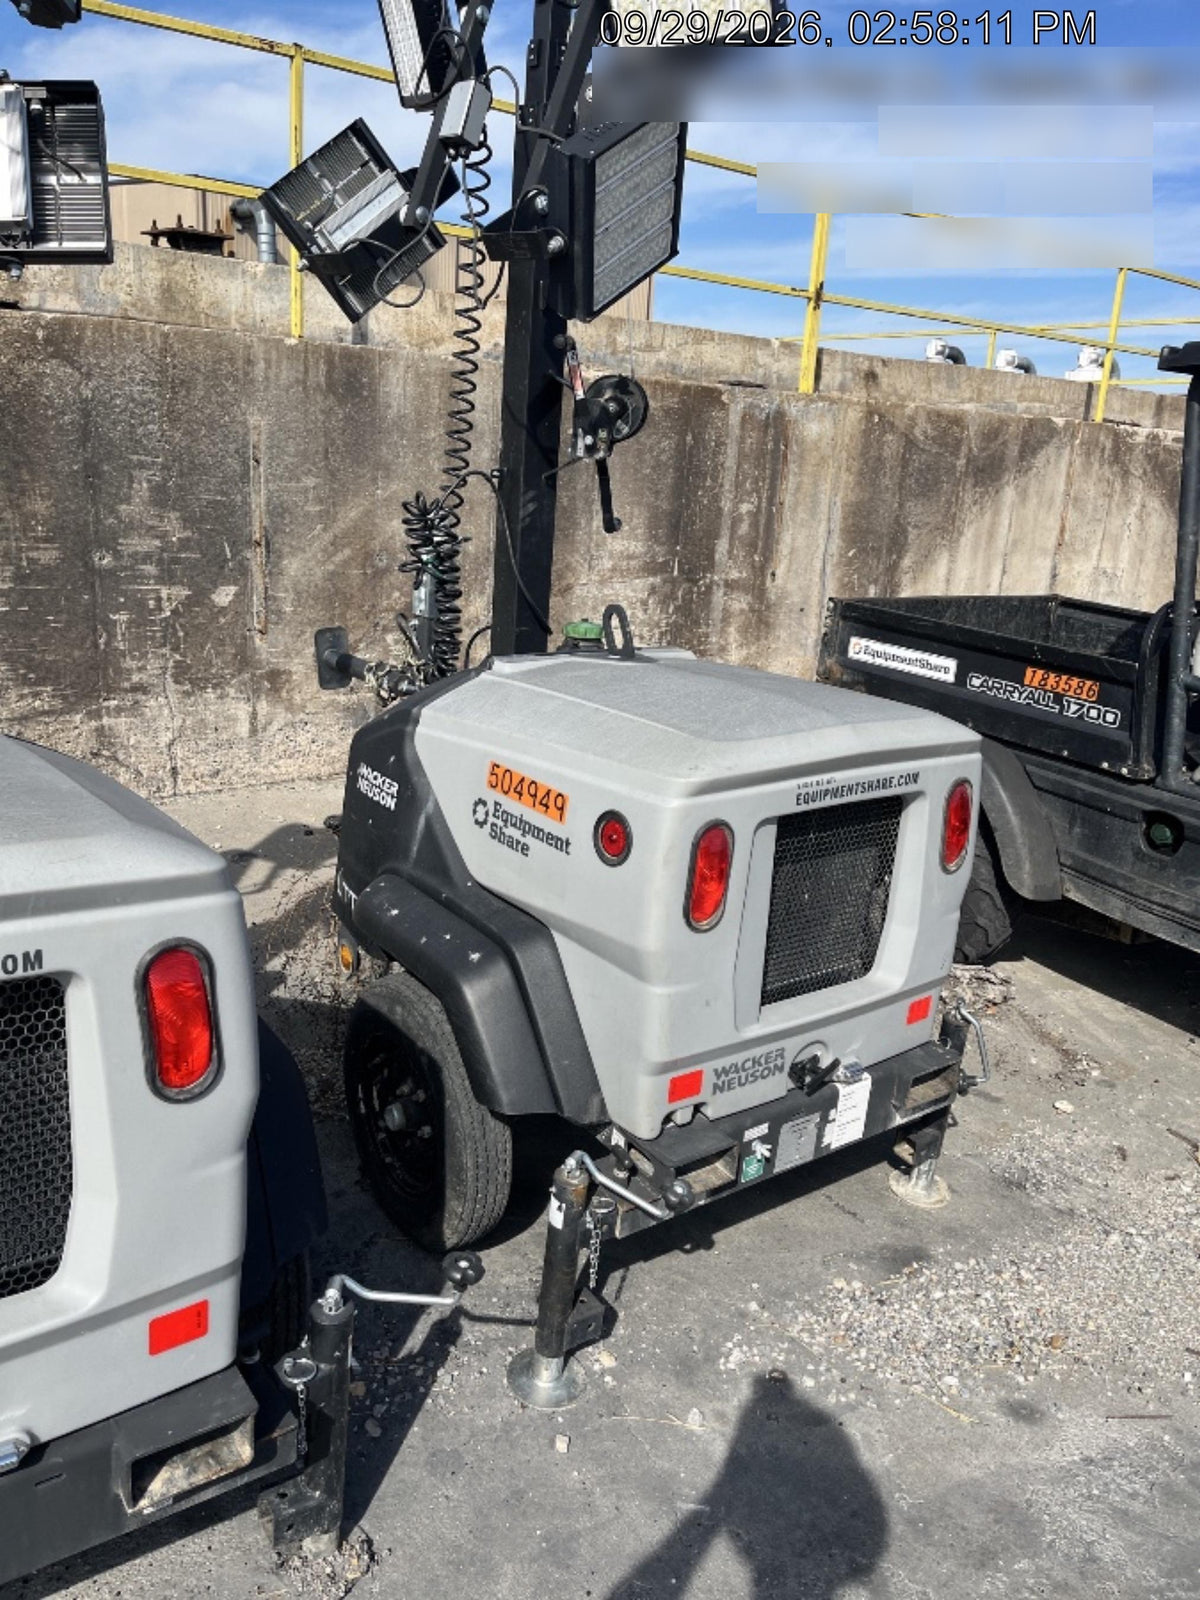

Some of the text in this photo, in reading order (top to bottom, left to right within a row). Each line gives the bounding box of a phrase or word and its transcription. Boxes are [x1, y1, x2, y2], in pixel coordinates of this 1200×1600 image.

[967, 672, 1121, 728] CARRYALL 1700
[1028, 669, 1098, 699] 183586
[357, 762, 399, 797] WACKER
[357, 775, 398, 811] NEUSON
[488, 762, 566, 823] 504949
[796, 771, 920, 806] EQUIPMENTSHARE.COM
[489, 822, 530, 858] Share
[492, 800, 572, 856] Equipment
[712, 1061, 785, 1096] NEUSON
[713, 1046, 785, 1081] WACKER
